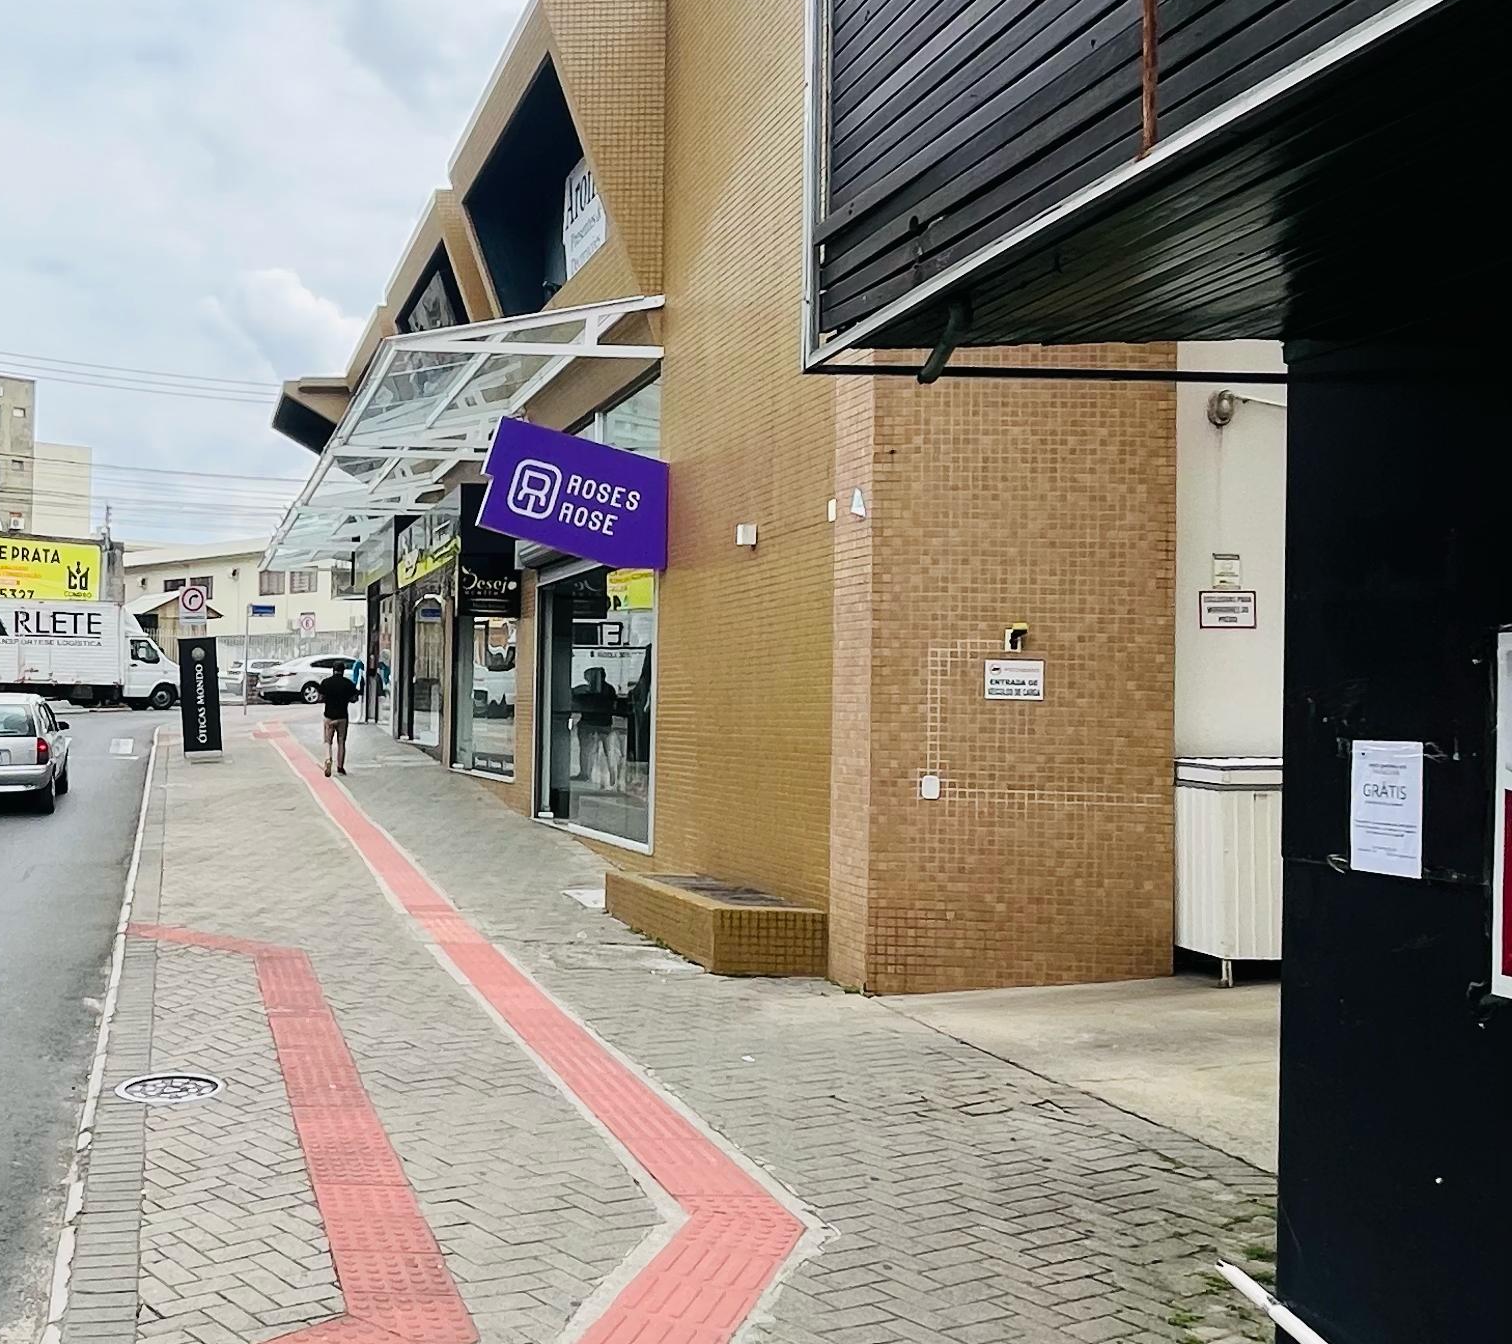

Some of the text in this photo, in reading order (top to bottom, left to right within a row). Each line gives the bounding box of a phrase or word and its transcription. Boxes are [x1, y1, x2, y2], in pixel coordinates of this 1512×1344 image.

[566, 474, 641, 511] ROSES
[558, 502, 619, 536] ROSE
[0, 545, 7, 560] E
[11, 546, 60, 564] PRATA
[461, 566, 517, 594] Desejo
[195, 664, 207, 744] ÓTICAS MONDO
[1363, 781, 1407, 800] GRÁTIS
